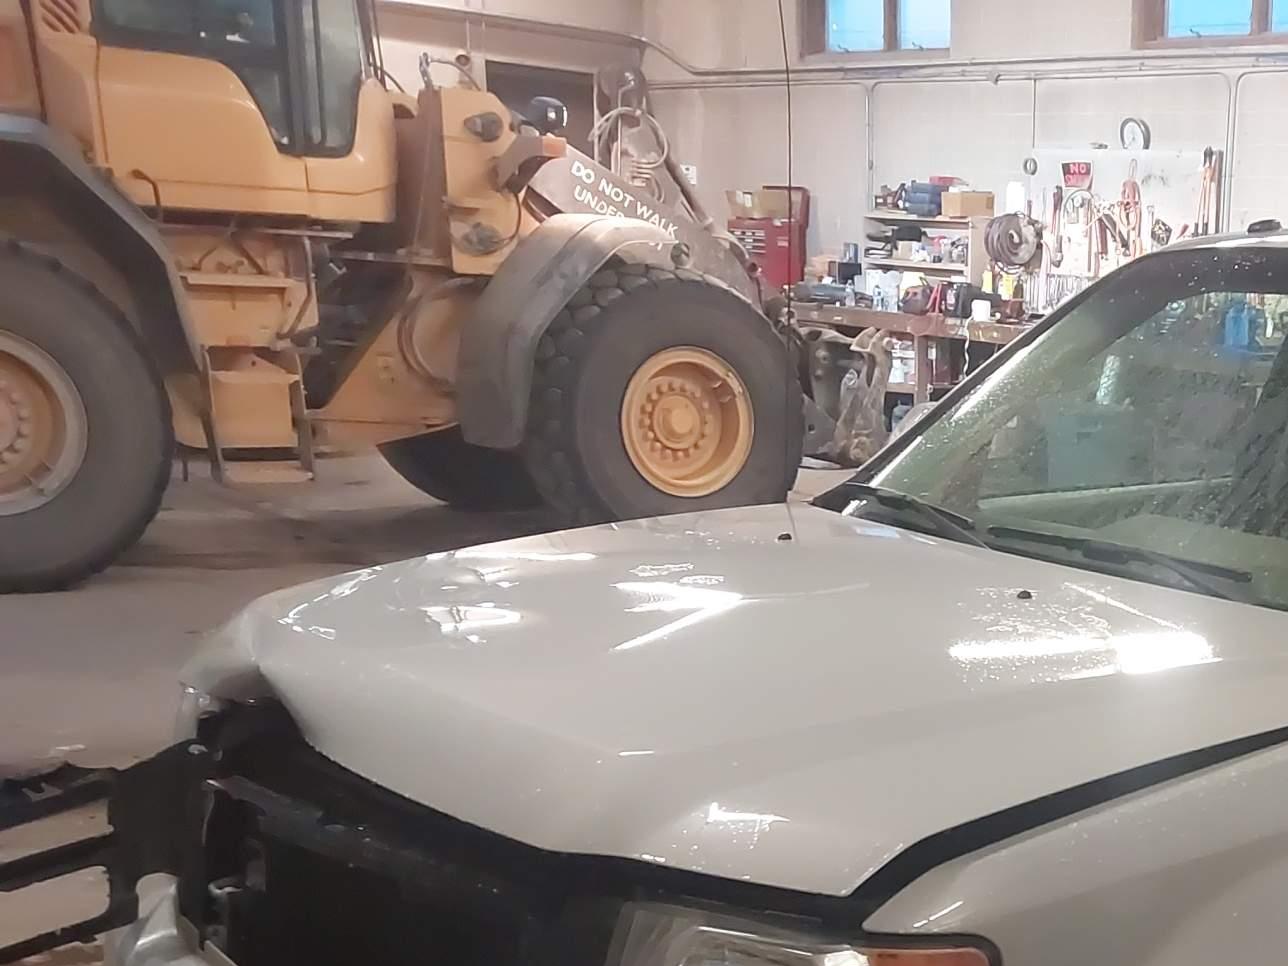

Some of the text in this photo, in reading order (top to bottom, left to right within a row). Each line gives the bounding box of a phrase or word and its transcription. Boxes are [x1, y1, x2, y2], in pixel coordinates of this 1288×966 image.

[1069, 162, 1087, 174] NO
[571, 160, 678, 241] DO NOT WALK
